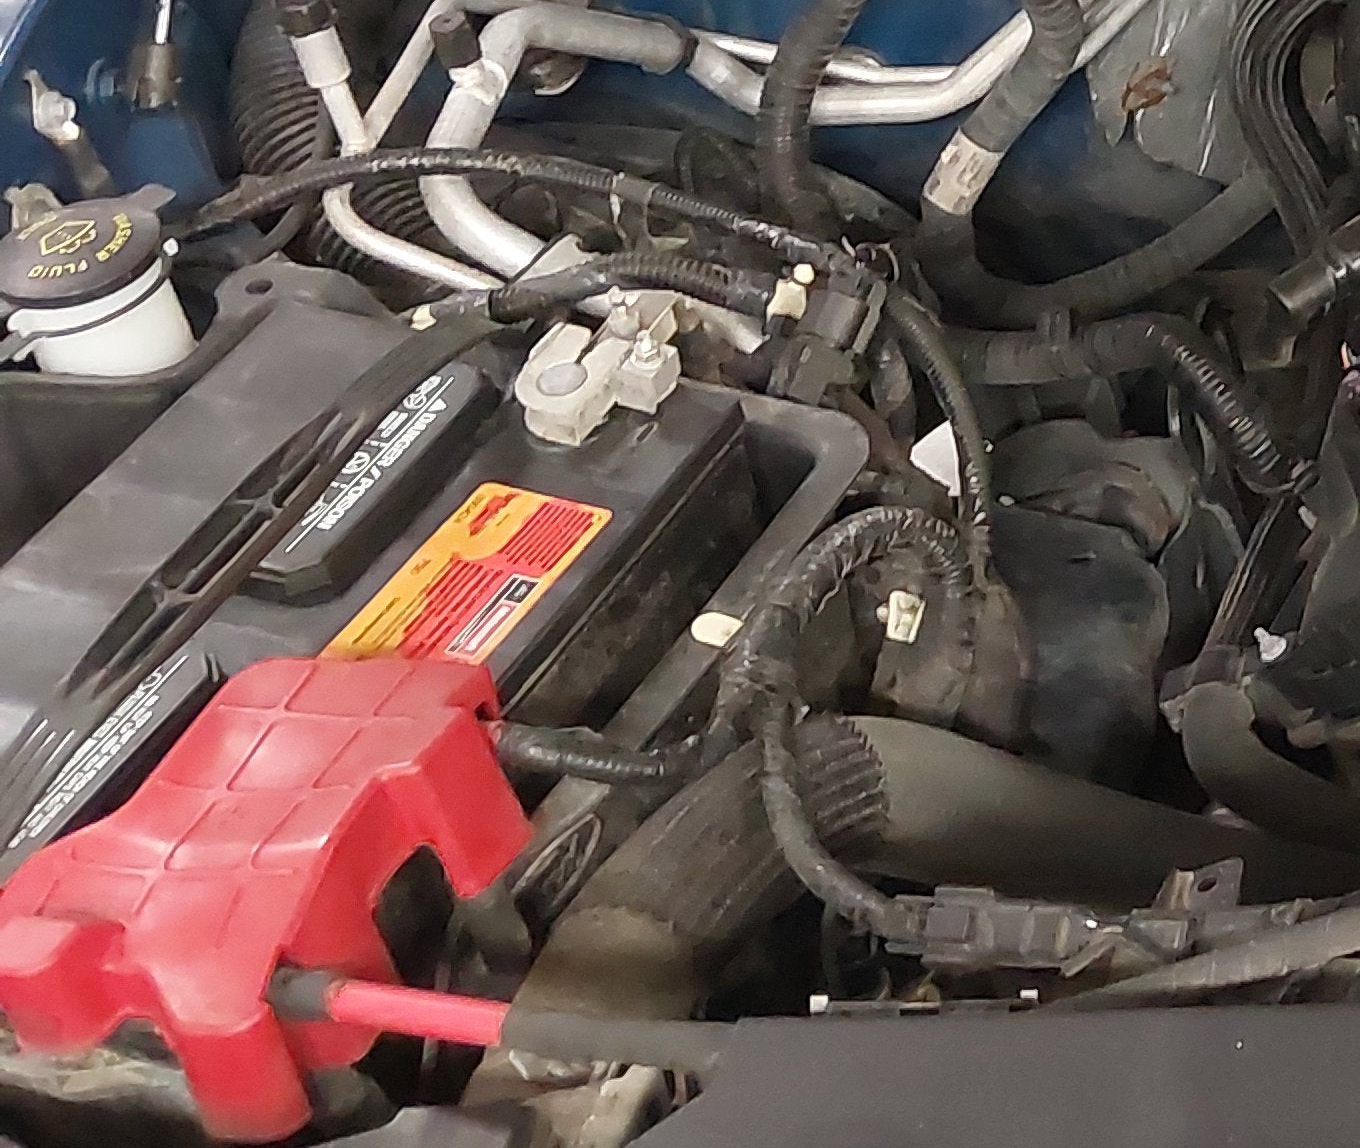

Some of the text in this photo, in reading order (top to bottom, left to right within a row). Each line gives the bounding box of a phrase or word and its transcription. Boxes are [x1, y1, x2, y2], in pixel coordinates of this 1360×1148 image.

[27, 259, 89, 279] FLUID
[376, 412, 437, 467] DANGER
[316, 477, 375, 530] POISON
